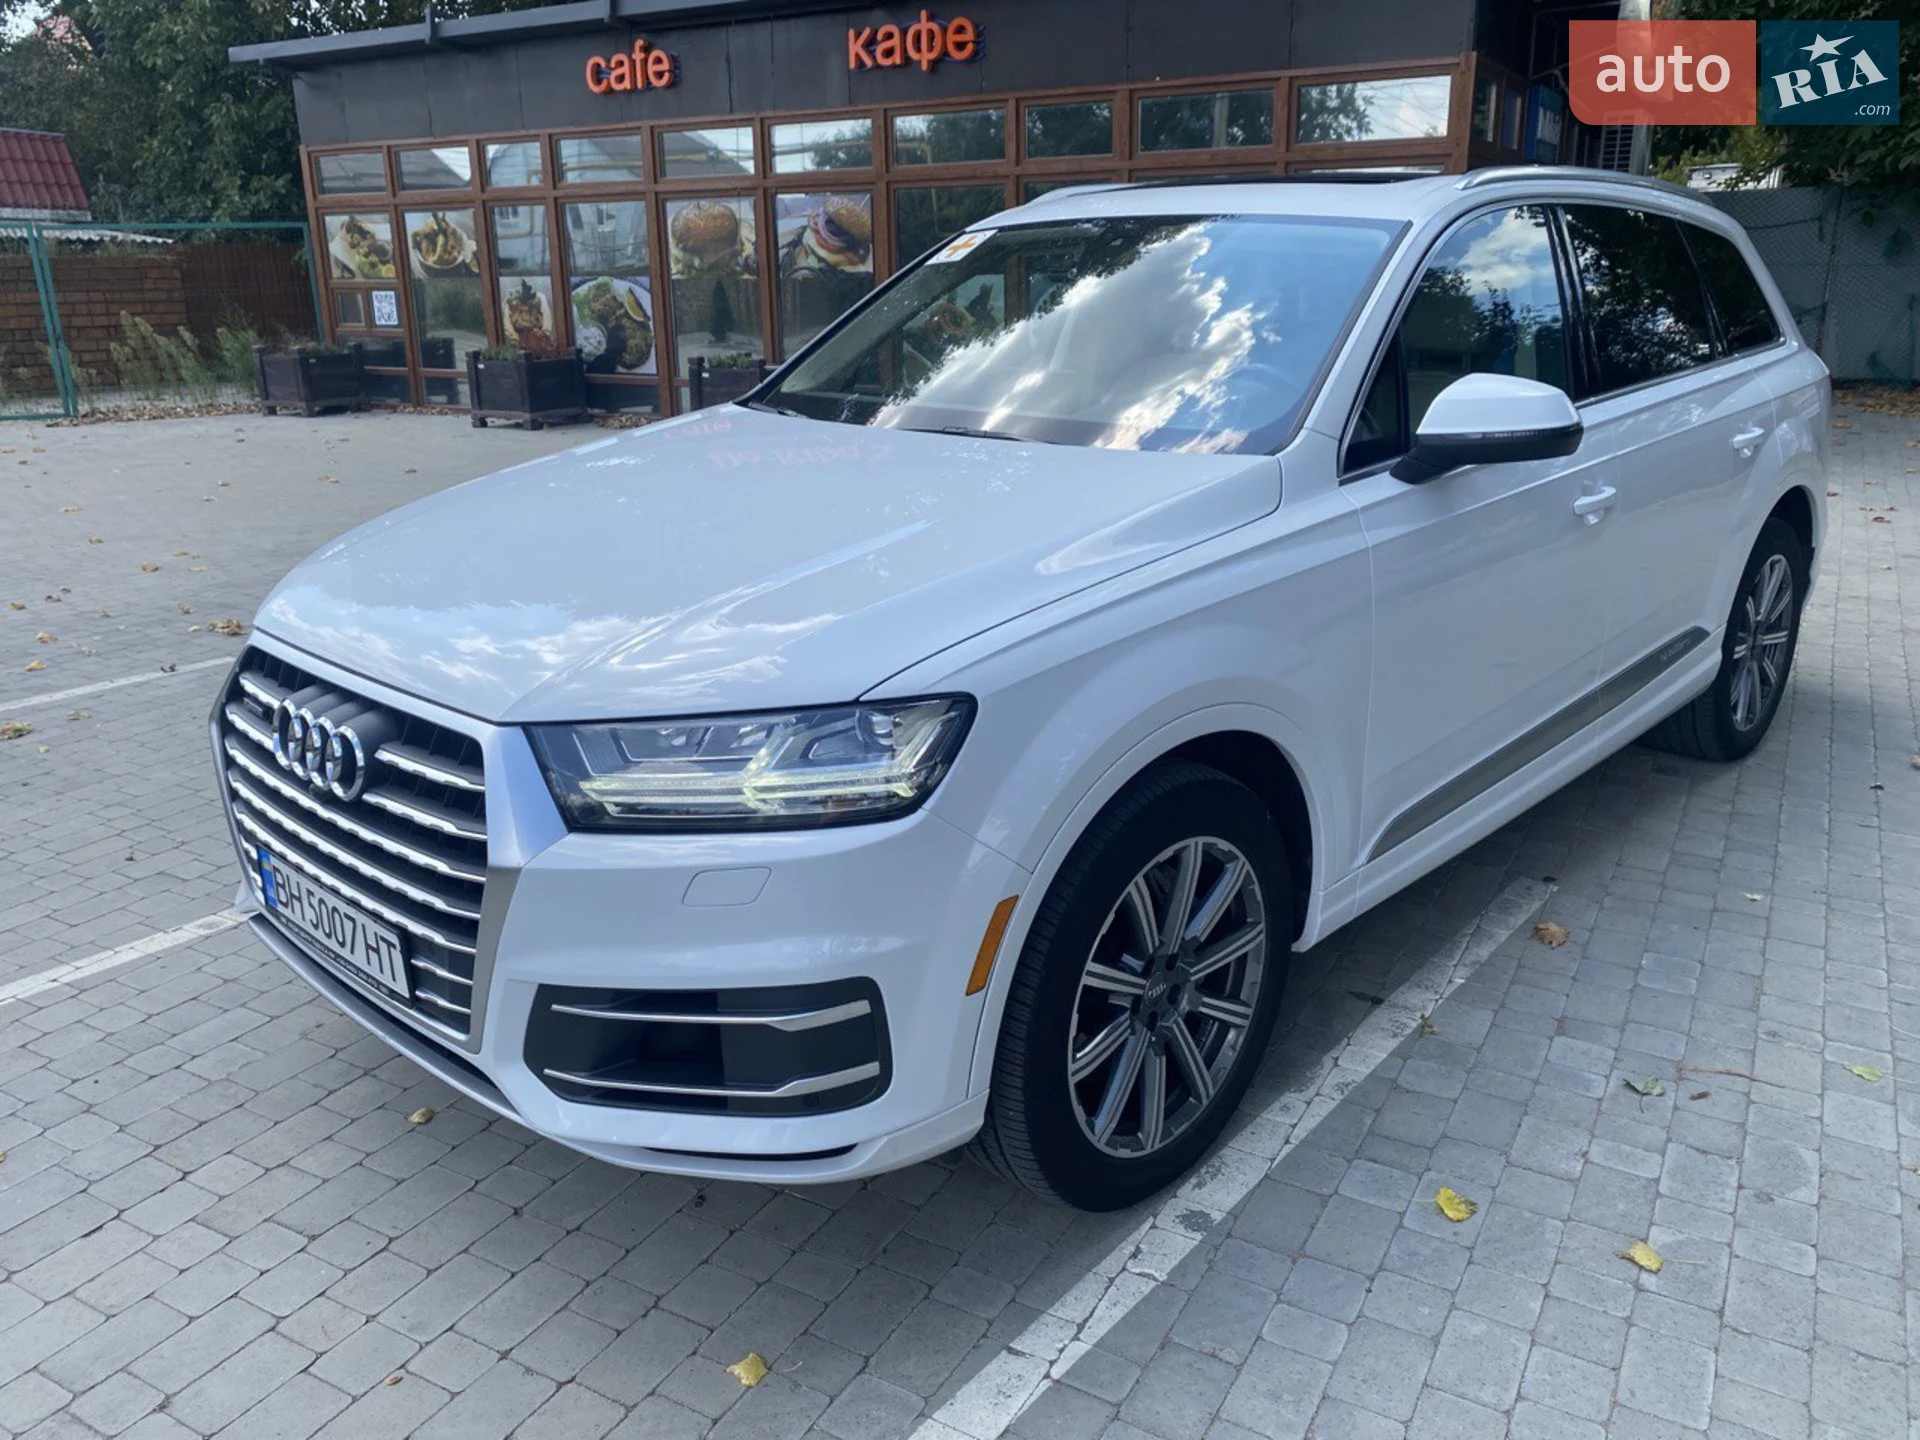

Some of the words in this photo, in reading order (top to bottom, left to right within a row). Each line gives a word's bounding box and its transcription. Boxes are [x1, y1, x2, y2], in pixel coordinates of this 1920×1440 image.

[585, 38, 671, 93] cafe
[848, 9, 976, 72] кафе
[272, 865, 306, 922] BH
[306, 887, 357, 955] 5007
[361, 922, 397, 983] HT
